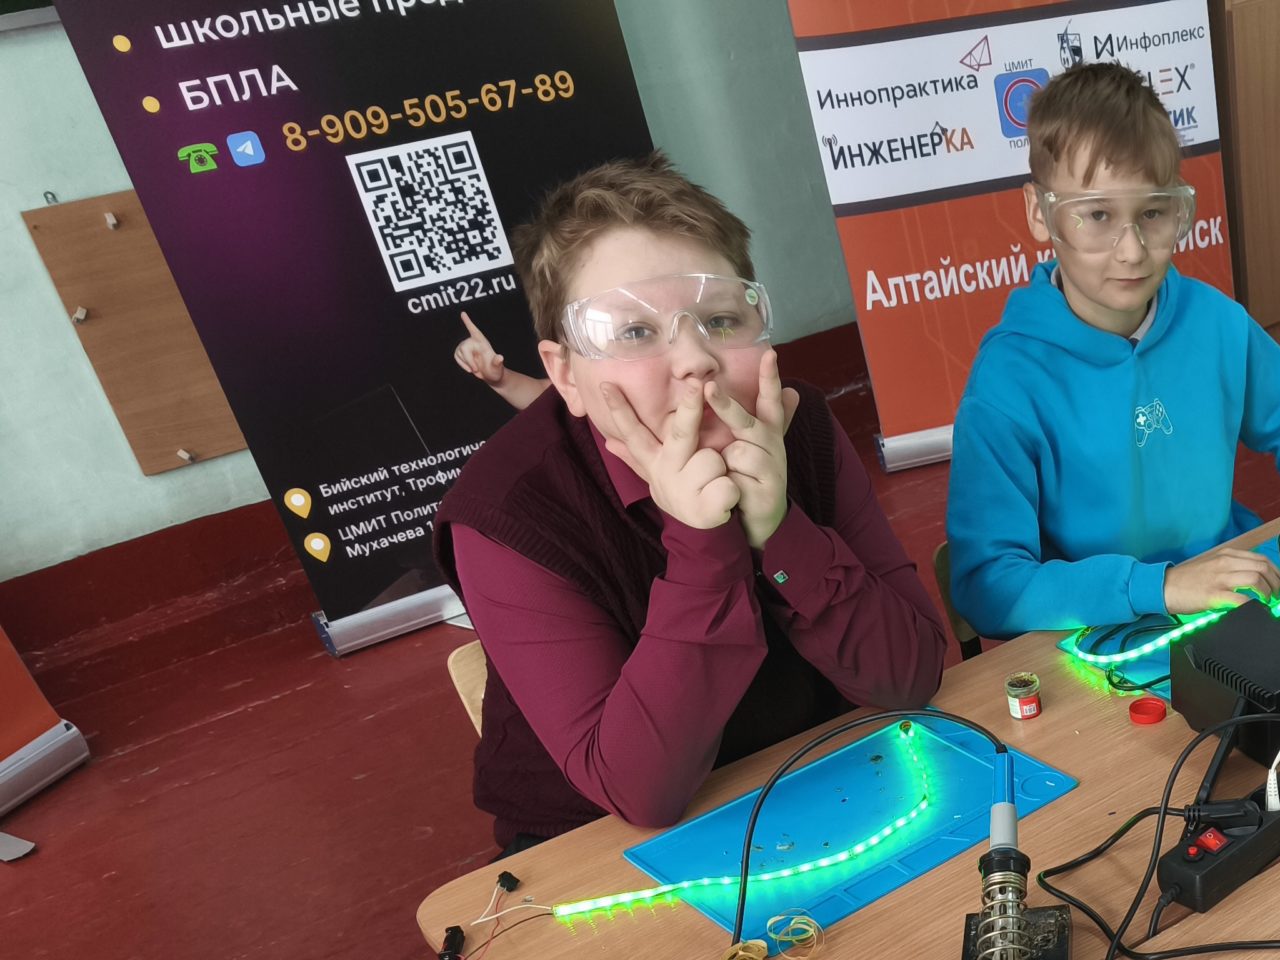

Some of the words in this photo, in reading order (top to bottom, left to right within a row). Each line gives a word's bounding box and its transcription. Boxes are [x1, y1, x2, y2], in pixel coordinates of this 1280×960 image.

[154, 0, 361, 49] школьные
[1116, 25, 1206, 53] Инфоплекс
[1004, 58, 1034, 72] ЦМИТ
[178, 64, 298, 111] БПЛА
[816, 73, 979, 110] Иннопрактика
[282, 70, 575, 152] 8-909-505-67-89
[829, 127, 975, 170] ИНЖЕНЕРКА
[1009, 138, 1030, 149] ПОЛ
[407, 274, 516, 314] cmit22.ru
[866, 255, 1031, 311] Алтайский
[319, 468, 390, 498] Бийский
[328, 484, 406, 515] институт,
[338, 515, 387, 541] ЦМИТ
[391, 500, 443, 525] Полит
[345, 525, 425, 558] Мухачева
